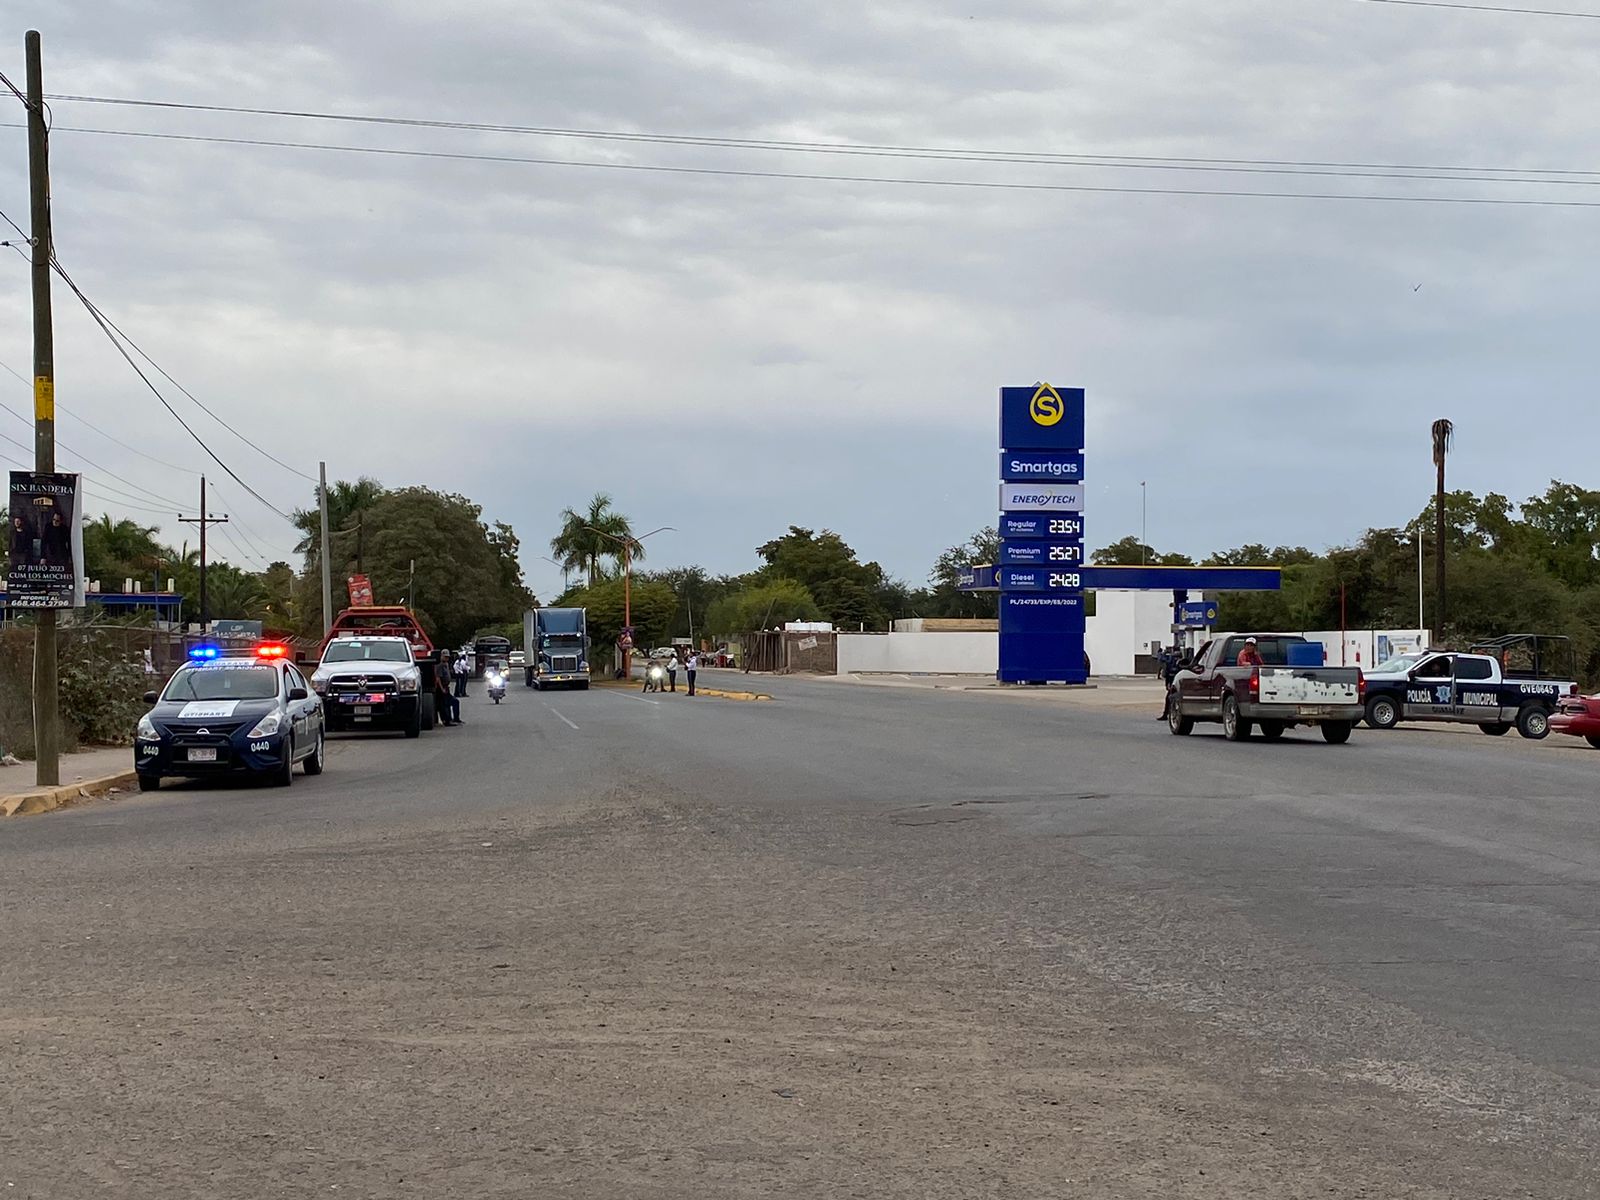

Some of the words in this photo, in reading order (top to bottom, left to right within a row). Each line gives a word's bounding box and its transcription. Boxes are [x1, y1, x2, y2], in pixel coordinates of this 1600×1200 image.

[1010, 460, 1078, 476] Smartgas
[11, 483, 27, 492] SIN
[30, 484, 74, 494] BANDERA
[1012, 494, 1076, 506] ENERGYTECH
[1007, 520, 1037, 528] Regular
[1407, 688, 1432, 703] POLICÍA
[1463, 692, 1499, 706] MUNICIPAL
[143, 745, 159, 756] 0440
[250, 741, 270, 752] 0440
